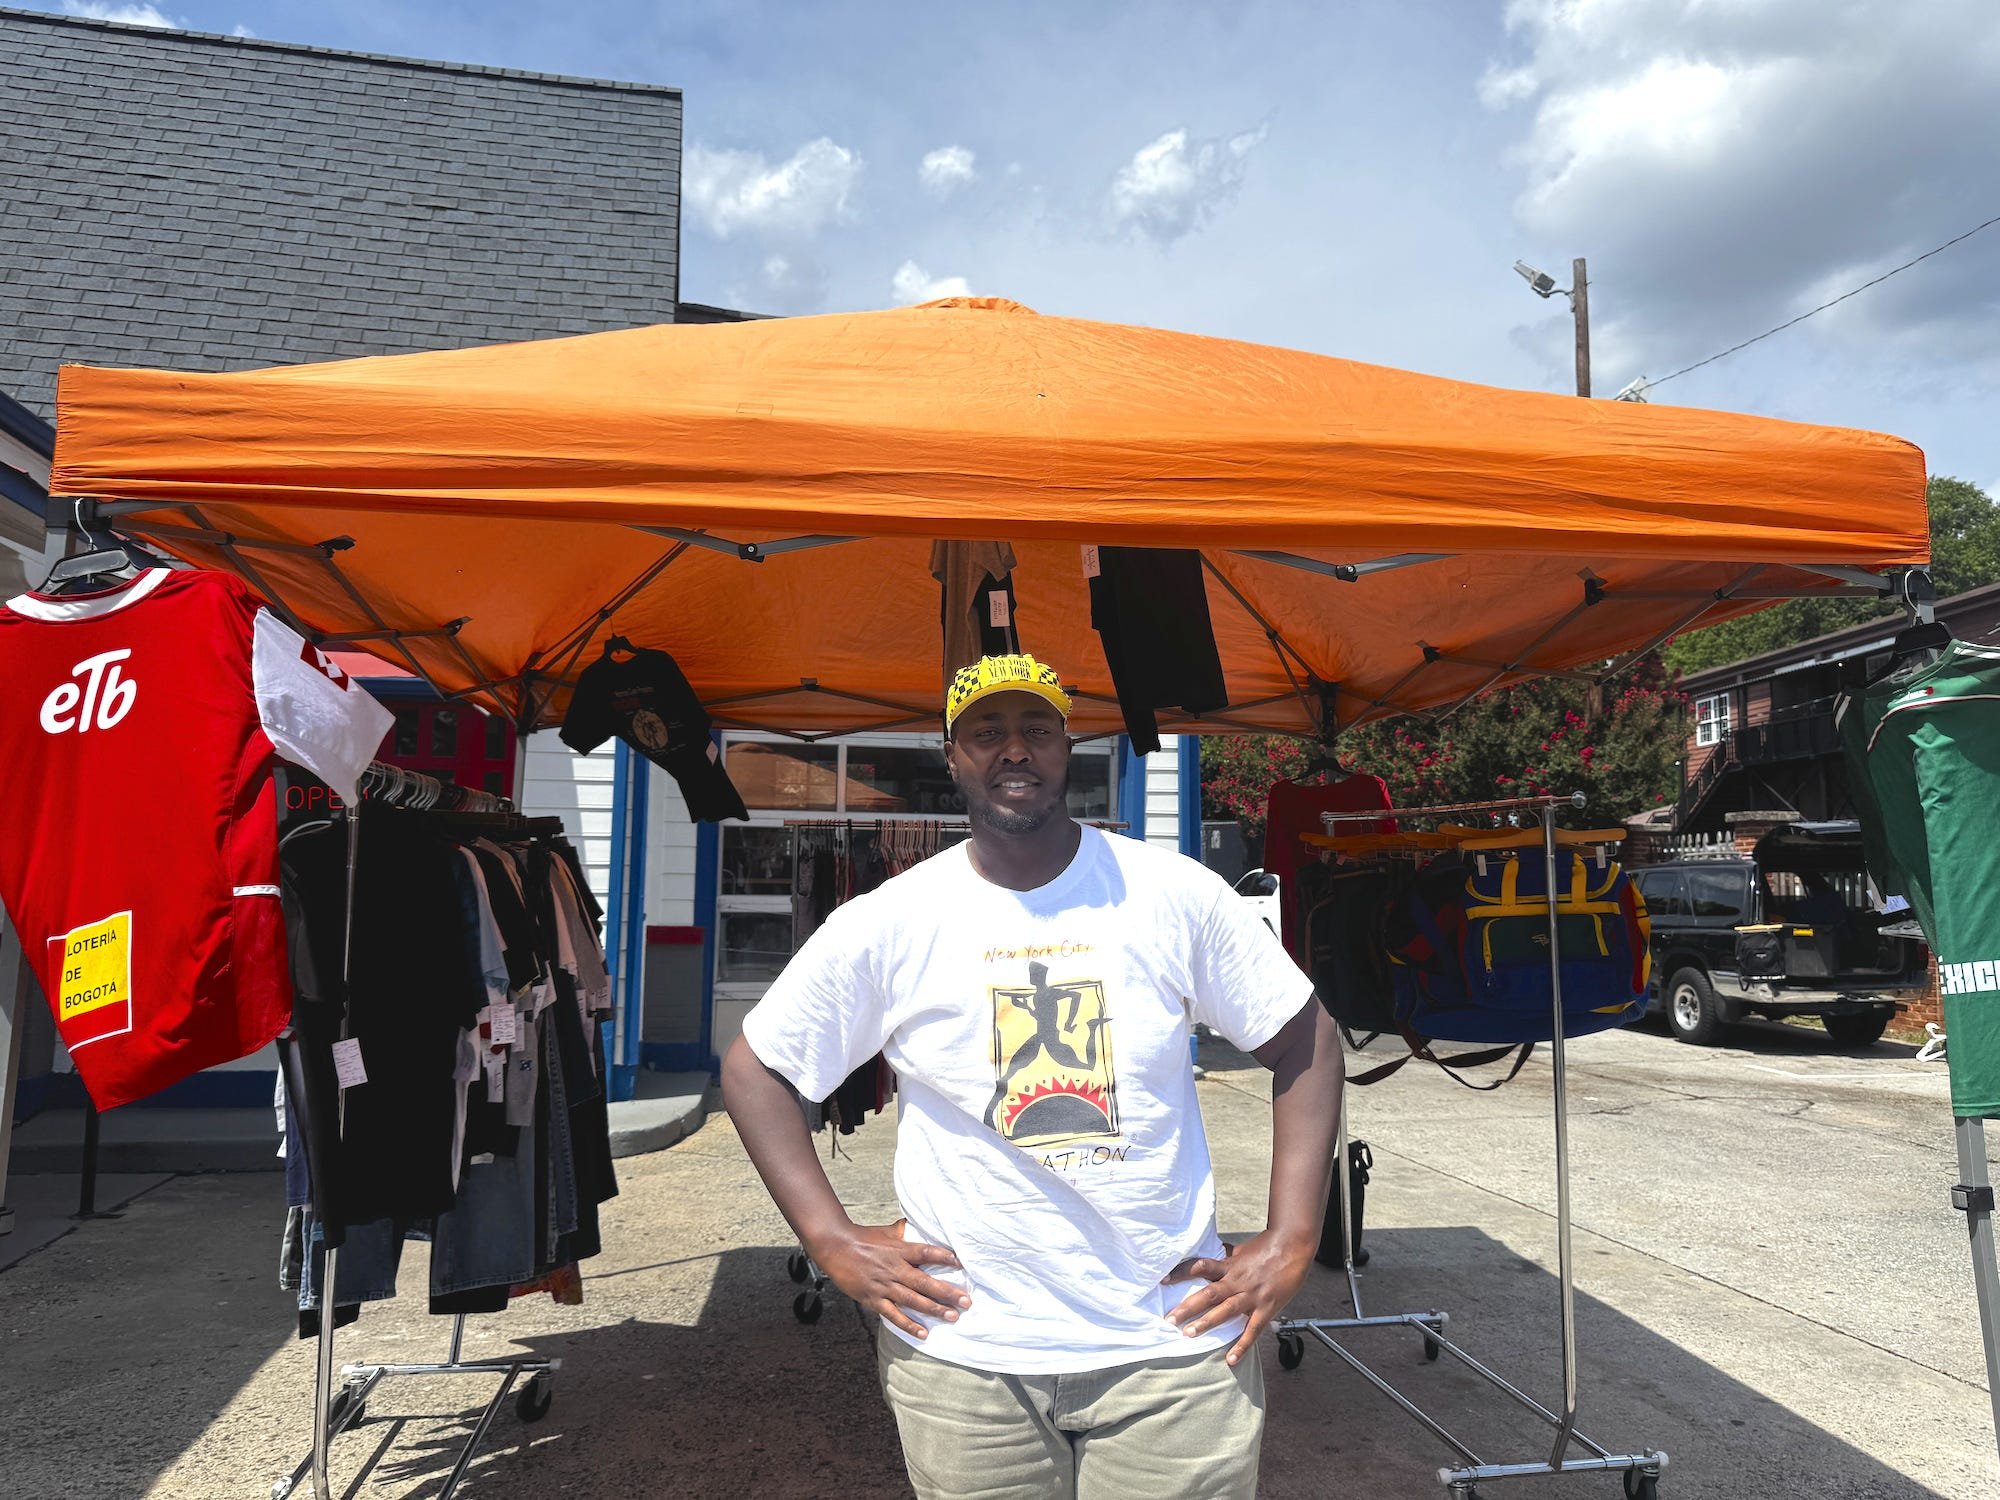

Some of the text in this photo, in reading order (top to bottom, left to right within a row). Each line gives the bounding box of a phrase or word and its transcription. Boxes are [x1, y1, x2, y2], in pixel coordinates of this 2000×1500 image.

[989, 666, 1032, 679] NEW YORK
[285, 785, 368, 810] OPE
[67, 928, 117, 957] LOTERÍA
[984, 947, 1017, 963] New
[1024, 945, 1054, 961] York
[65, 967, 82, 983] DE
[65, 980, 117, 1009] BOGOTÁ
